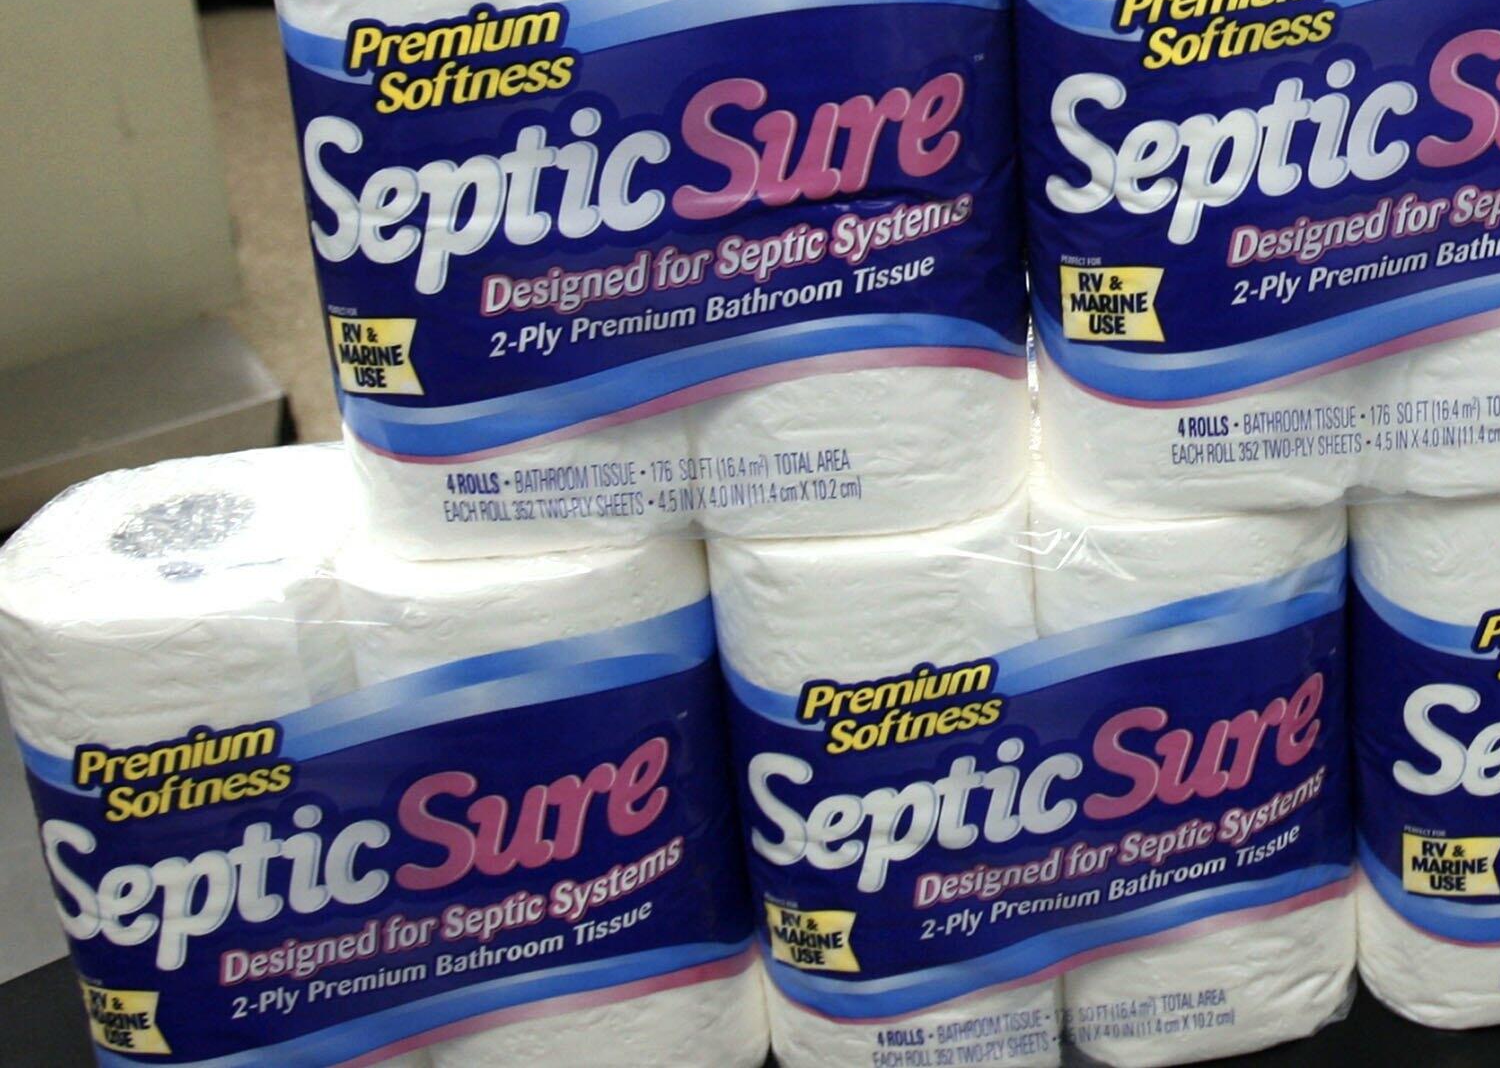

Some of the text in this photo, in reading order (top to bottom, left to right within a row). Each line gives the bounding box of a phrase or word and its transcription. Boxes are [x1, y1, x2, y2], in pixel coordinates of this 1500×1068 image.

[350, 11, 561, 68] Premium
[1143, 10, 1335, 69] Softness
[375, 55, 575, 114] Softness
[485, 195, 971, 314] Designed for Septic Systems
[1231, 200, 1390, 264] Designed
[1396, 195, 1447, 234] for
[1070, 292, 1148, 313] MARINE
[1078, 272, 1123, 292] RV &
[1232, 271, 1301, 305] 2-Ply
[1308, 251, 1427, 292] Premium
[342, 322, 377, 343] RV &
[489, 256, 935, 357] 2-Ply Premium Bathroom Tissue
[1089, 314, 1126, 334] USE
[354, 366, 387, 388] USE
[1172, 444, 1203, 464] EACH
[1207, 442, 1235, 464] ROLL
[1239, 441, 1259, 462] 352
[1262, 437, 1314, 459] TWO-PLY
[1318, 434, 1362, 455] SHEETS
[1375, 431, 1392, 451] 4.5
[1395, 430, 1408, 450] IN
[1411, 429, 1419, 449] X
[1422, 428, 1439, 448] 4.0
[1443, 426, 1455, 446] IN
[1457, 424, 1485, 448] (11.4
[1178, 418, 1184, 437] 4
[1189, 415, 1229, 437] ROLLS
[1243, 409, 1312, 435] BATHROOM
[1315, 405, 1356, 430] TISSUE
[1370, 404, 1390, 426] 176
[1397, 402, 1413, 424] SQ
[1416, 401, 1429, 422] FT
[1432, 399, 1459, 423] (16.4
[447, 461, 636, 494] 4 ROLLS BATHROOM TISSUE
[803, 664, 991, 719] Premium
[826, 698, 1002, 754] Softness
[78, 727, 275, 784] Premium
[106, 764, 293, 822] Softness
[918, 767, 1325, 905] Designed for Septic Systems
[1422, 840, 1465, 858] RV &
[920, 825, 1300, 940] 2-Ply Premium Bathroom Tissue
[1412, 856, 1488, 875] MARINE
[1430, 875, 1466, 891] USE
[224, 837, 683, 983] Designed for Septic Systems
[807, 918, 818, 931] &
[232, 901, 652, 1019] 2-Ply Premium Bathroom Tissue
[790, 946, 825, 965] USE
